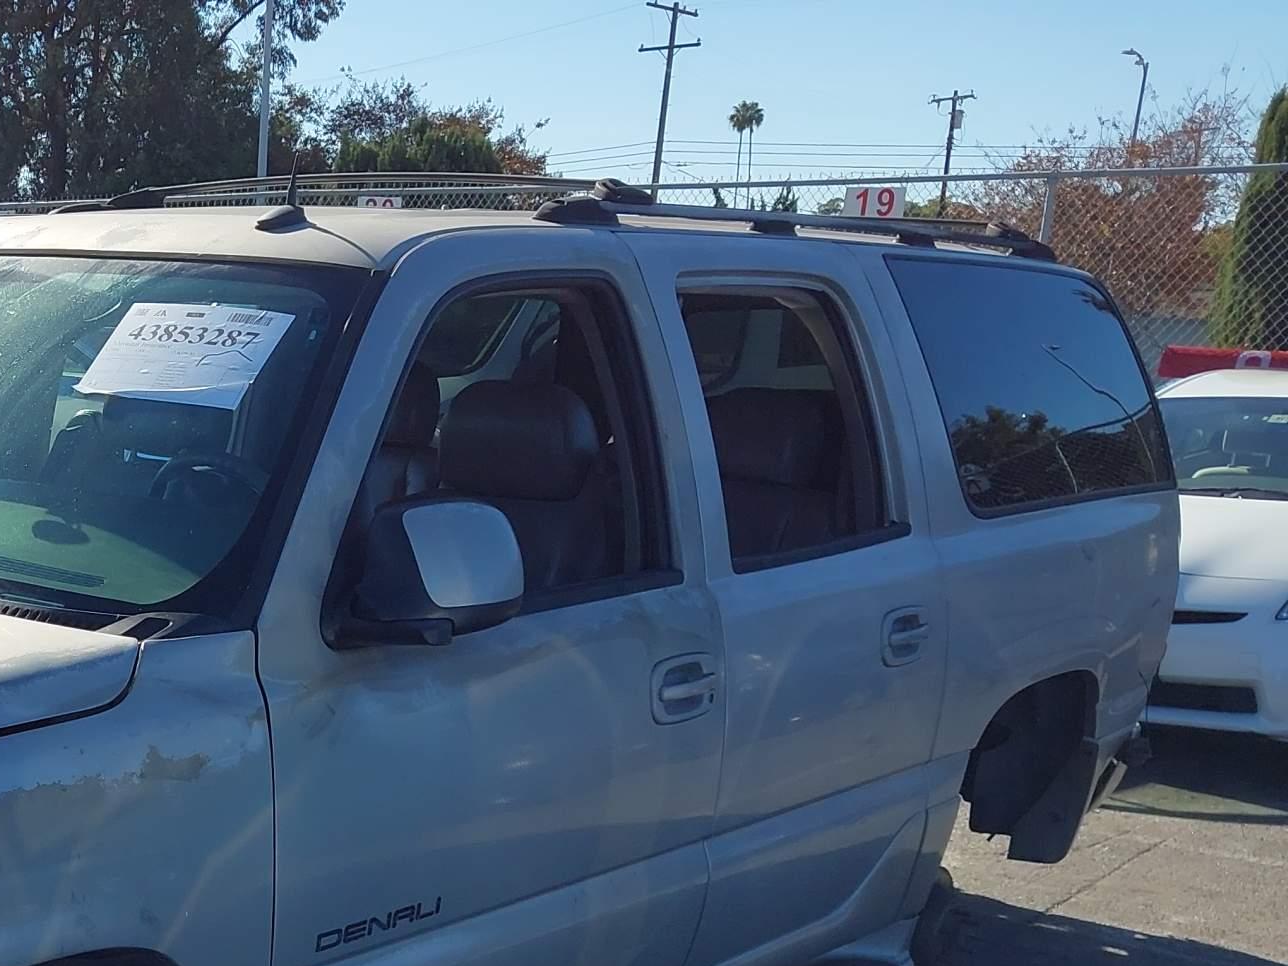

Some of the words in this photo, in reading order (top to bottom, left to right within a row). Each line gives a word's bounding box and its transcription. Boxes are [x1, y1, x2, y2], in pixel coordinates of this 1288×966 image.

[856, 187, 895, 217] 19
[128, 323, 261, 350] 43853287
[315, 896, 442, 953] DENALI
